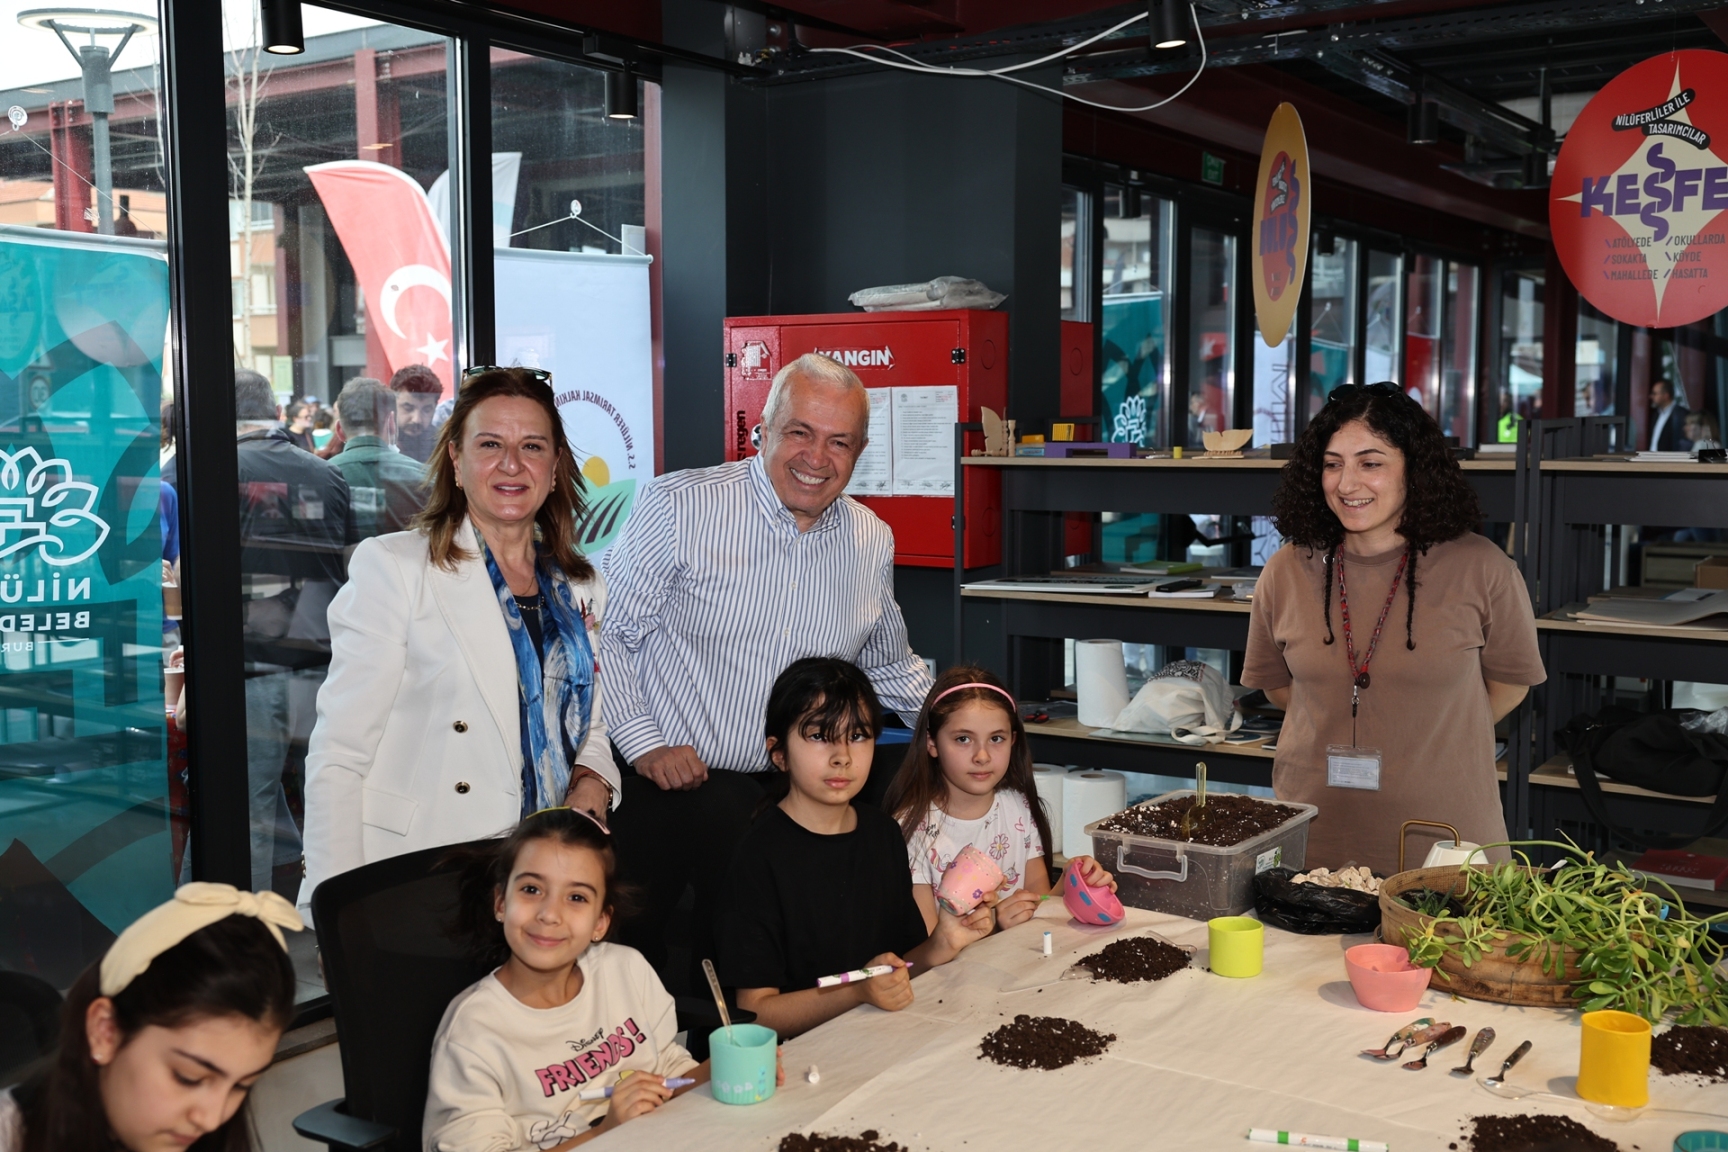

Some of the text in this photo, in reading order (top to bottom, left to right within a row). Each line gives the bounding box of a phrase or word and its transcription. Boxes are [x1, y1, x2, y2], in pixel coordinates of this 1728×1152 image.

[1615, 92, 1690, 126] NİLÜFERLİLER İLE
[1648, 123, 1706, 145] TASARIMCILAR
[1612, 237, 1652, 248] ATÖLYEDE
[1674, 234, 1726, 246] OKULLARDA
[1611, 254, 1647, 265] SOKAKTA
[1673, 250, 1702, 262] KÖYDE
[1611, 269, 1658, 280] MAHALLEDE
[1672, 268, 1708, 279] HASATTA
[534, 1017, 647, 1098] FRIENDS!
